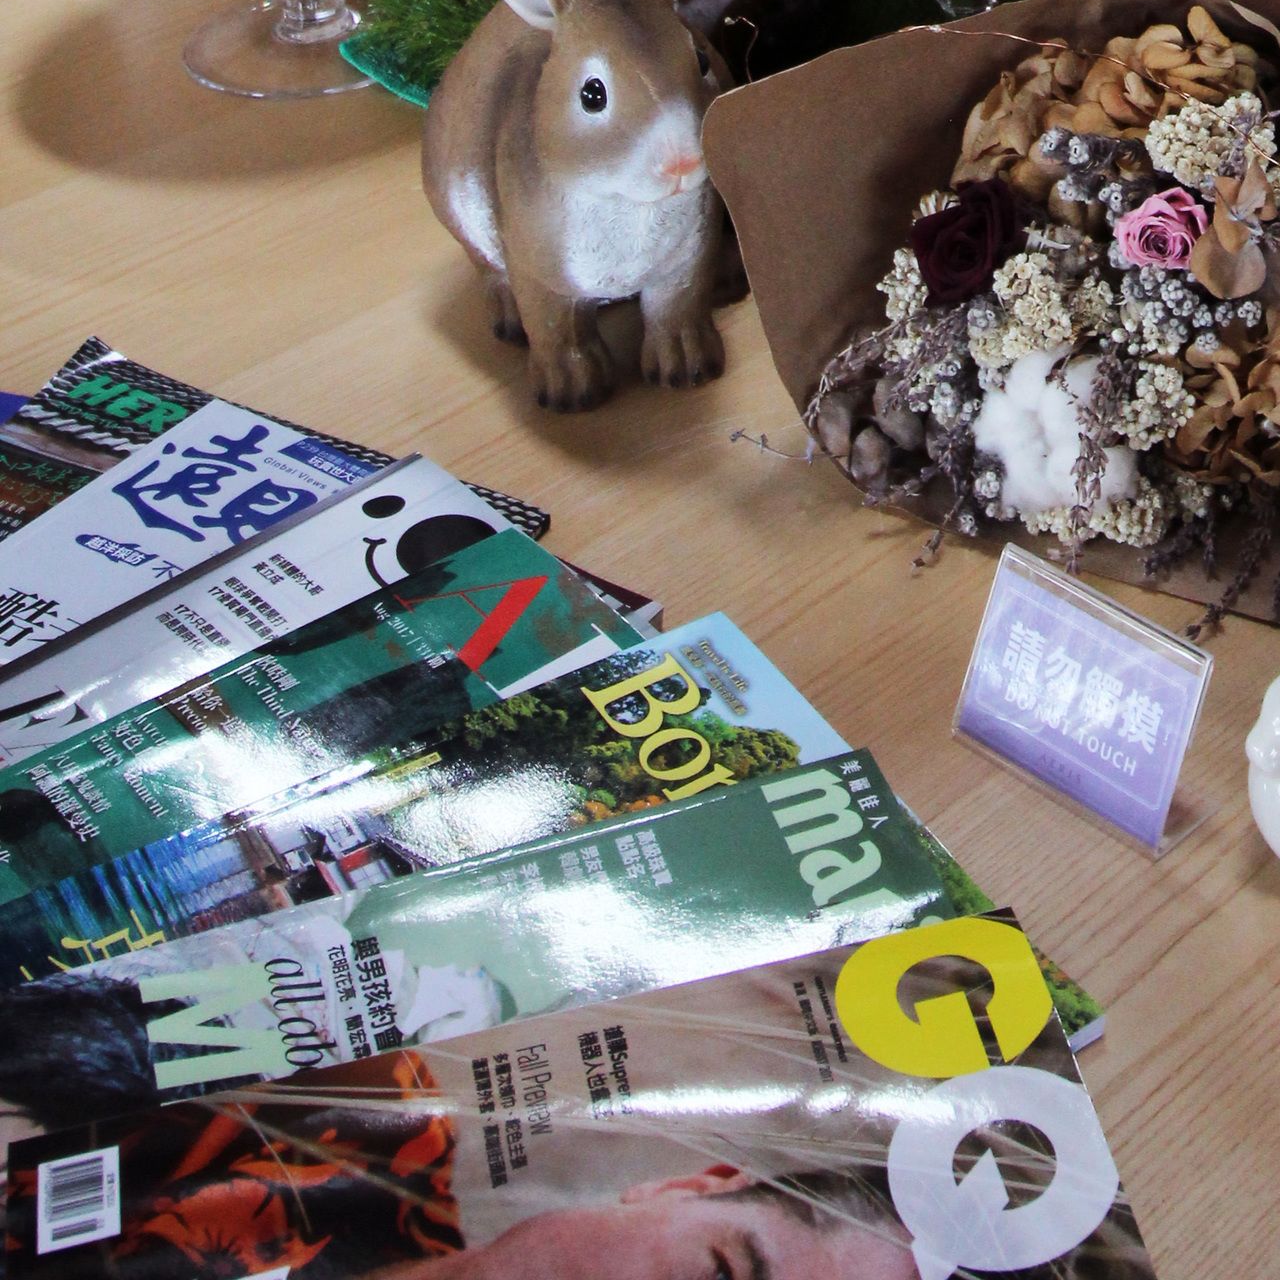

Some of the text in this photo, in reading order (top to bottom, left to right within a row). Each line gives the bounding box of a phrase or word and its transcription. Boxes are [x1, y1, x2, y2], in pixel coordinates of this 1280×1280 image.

[67, 373, 188, 433] HER
[264, 456, 327, 490] Global Views
[251, 561, 284, 585] 黃立成
[268, 553, 324, 596] 新媒體的大哥
[256, 684, 295, 720] Third
[1002, 620, 1164, 754] 請勿觸摸
[1077, 727, 1137, 776] TOUCH
[838, 759, 889, 829] 美麗佳人
[351, 936, 404, 1051] 與男孩約會
[277, 1016, 339, 1070] ab
[516, 1043, 552, 1135] Fall Preview
[835, 916, 1120, 1280] GQ
